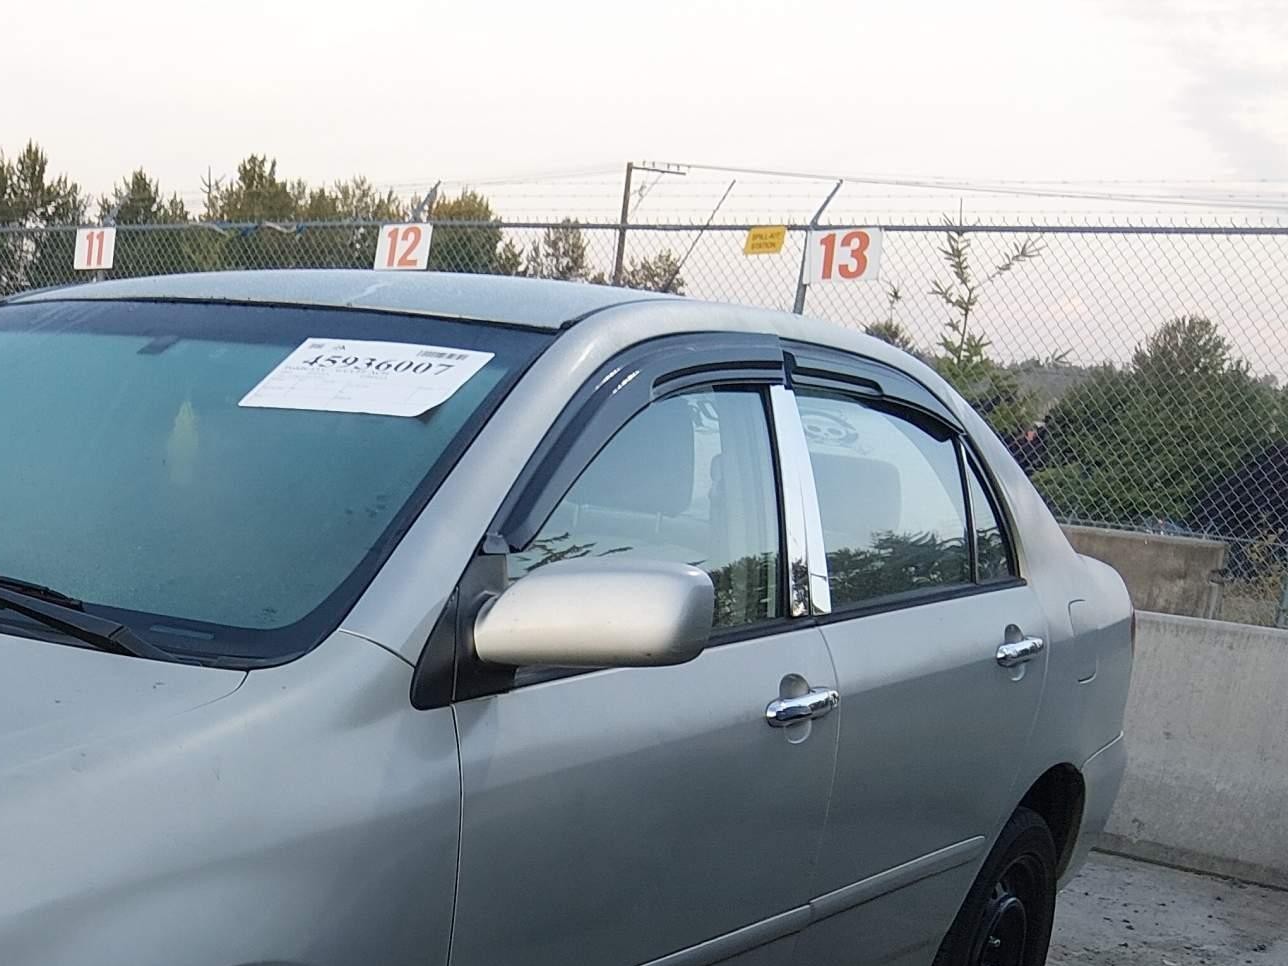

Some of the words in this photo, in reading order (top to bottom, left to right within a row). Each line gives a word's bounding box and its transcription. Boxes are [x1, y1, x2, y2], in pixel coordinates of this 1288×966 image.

[86, 231, 106, 268] 11
[386, 226, 422, 268] 12
[819, 230, 871, 281] 13
[302, 354, 454, 376] 45936007
